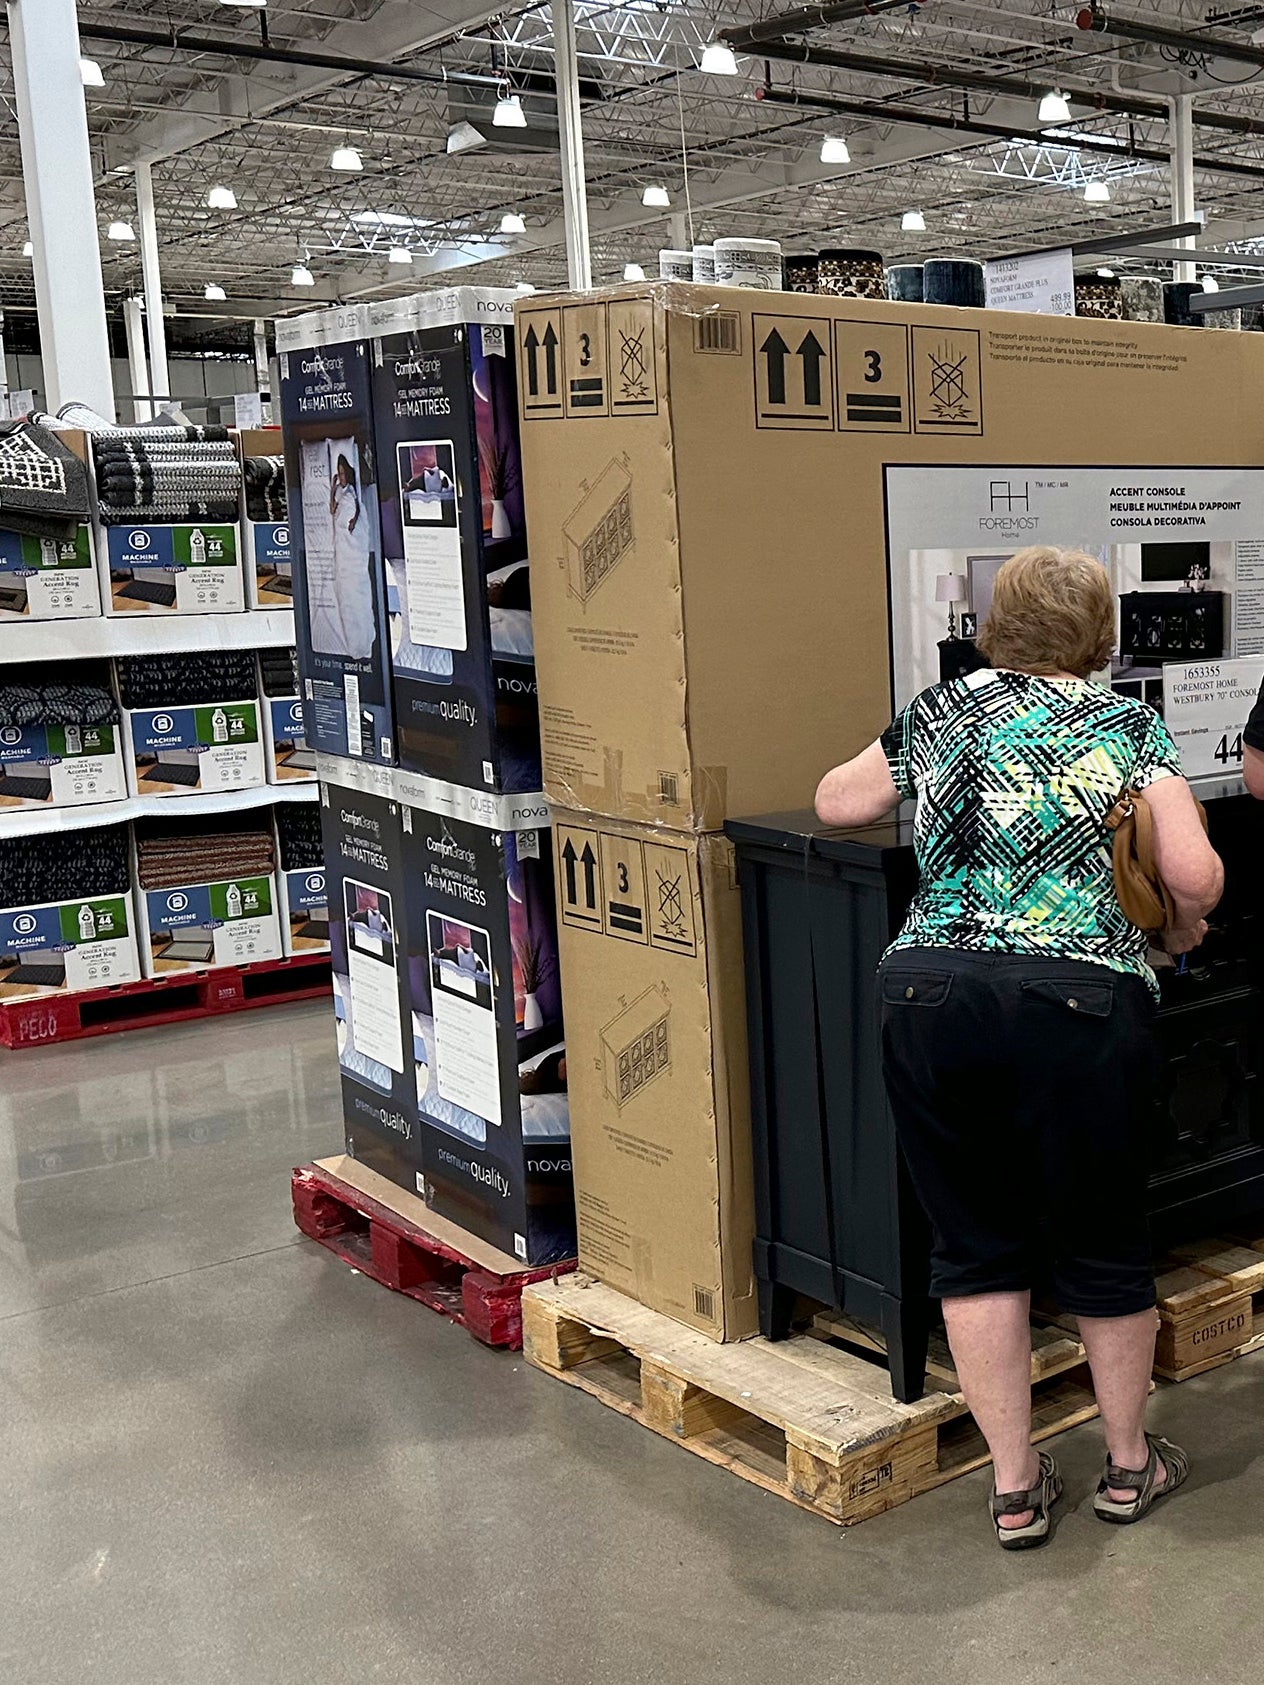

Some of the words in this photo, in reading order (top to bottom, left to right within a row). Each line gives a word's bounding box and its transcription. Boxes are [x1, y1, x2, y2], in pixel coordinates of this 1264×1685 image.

[477, 300, 514, 313] nova
[484, 327, 502, 338] 20
[580, 333, 591, 367] 3
[864, 350, 882, 383] 3
[313, 392, 353, 411] MATTRESS
[406, 397, 450, 417] MATTRESS
[1109, 487, 1144, 497] ACCENT
[1146, 487, 1186, 497] CONSOLE
[1109, 501, 1145, 512] MEUBLE
[1147, 500, 1197, 511] MULTIMÉDIA
[1199, 501, 1241, 511] D'APPOINT
[979, 517, 1040, 530] FOREMOST
[1110, 517, 1152, 527] CONSOLA
[1154, 516, 1206, 526] DECORATIVA
[1183, 665, 1221, 680] 1653355
[498, 676, 537, 694] nova
[1173, 680, 1214, 693] FOREMOST
[1216, 678, 1238, 689] HOME
[1173, 692, 1214, 705] WESTBURY
[1217, 690, 1228, 700] 70"
[1229, 687, 1260, 699] CONSOL
[1191, 727, 1209, 735] Savings
[146, 736, 182, 744] MACHINE
[1214, 731, 1243, 764] 44
[470, 796, 499, 815] QUEEN
[512, 804, 548, 819] nova
[519, 832, 536, 843] 20
[352, 845, 388, 871] MATTRESS
[441, 868, 461, 881] MEMORY
[617, 862, 629, 893] 3
[440, 875, 486, 906] MATTRESS
[300, 896, 327, 904] MACHIN
[161, 912, 197, 925] MACHINE
[7, 935, 46, 947] MACHINE
[20, 1016, 57, 1041] PECO
[527, 1159, 571, 1172] nova
[1192, 1313, 1245, 1345] COSTCO
